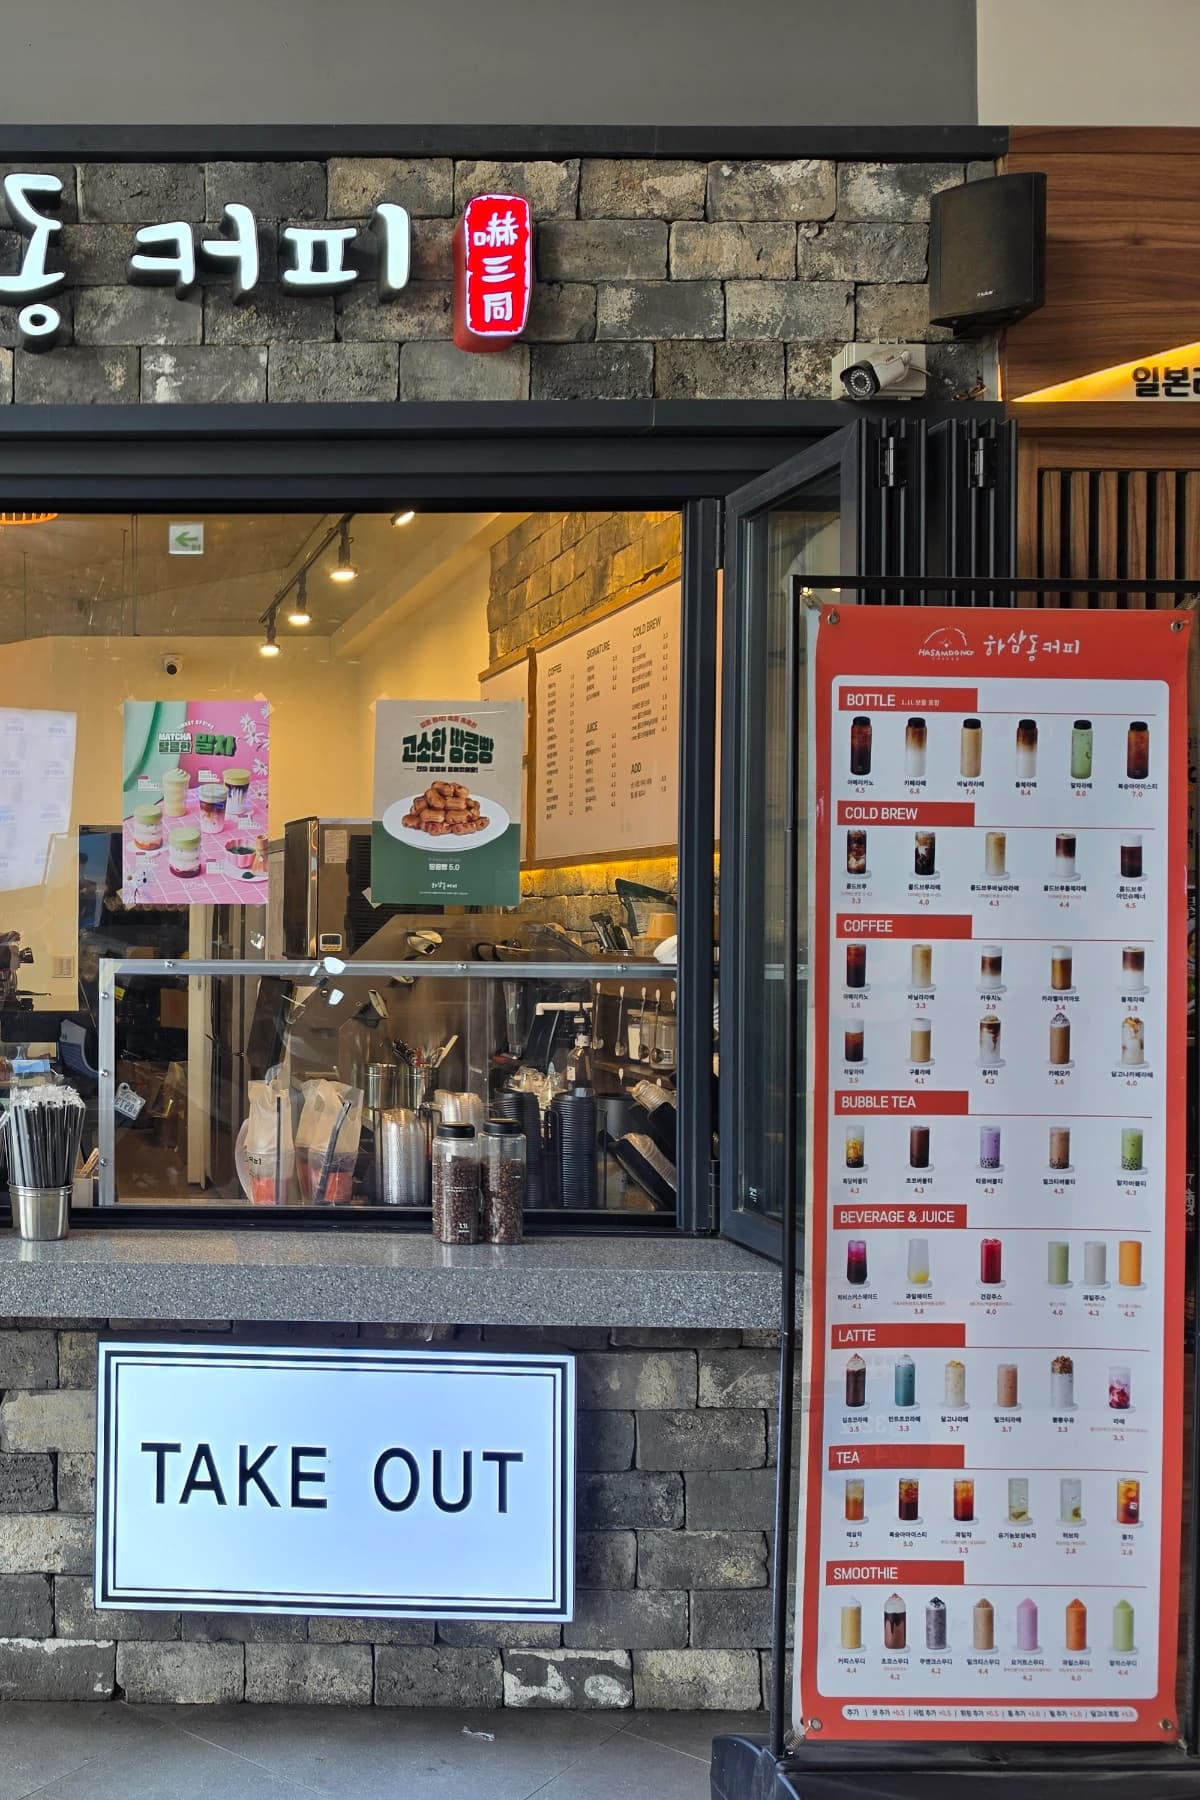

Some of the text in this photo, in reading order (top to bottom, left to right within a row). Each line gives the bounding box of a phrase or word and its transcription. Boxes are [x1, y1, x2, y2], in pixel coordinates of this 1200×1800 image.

[131, 204, 410, 291] 커피
[633, 616, 661, 638] COLD BREW
[847, 694, 896, 706] BOTTLE
[195, 734, 236, 757] 말차
[402, 727, 446, 763] 고소한
[631, 762, 641, 774] ADD
[845, 807, 918, 820] COLD BREW
[844, 920, 893, 932] COFFEE
[842, 1096, 916, 1108] BUBBLE TEA
[840, 1211, 955, 1223] BEVERAGE & JUICE
[838, 1329, 876, 1342] LATTE
[836, 1451, 860, 1464] TEA
[141, 1442, 524, 1514] TAKE OUT
[834, 1567, 898, 1579] SMOOTHIE
